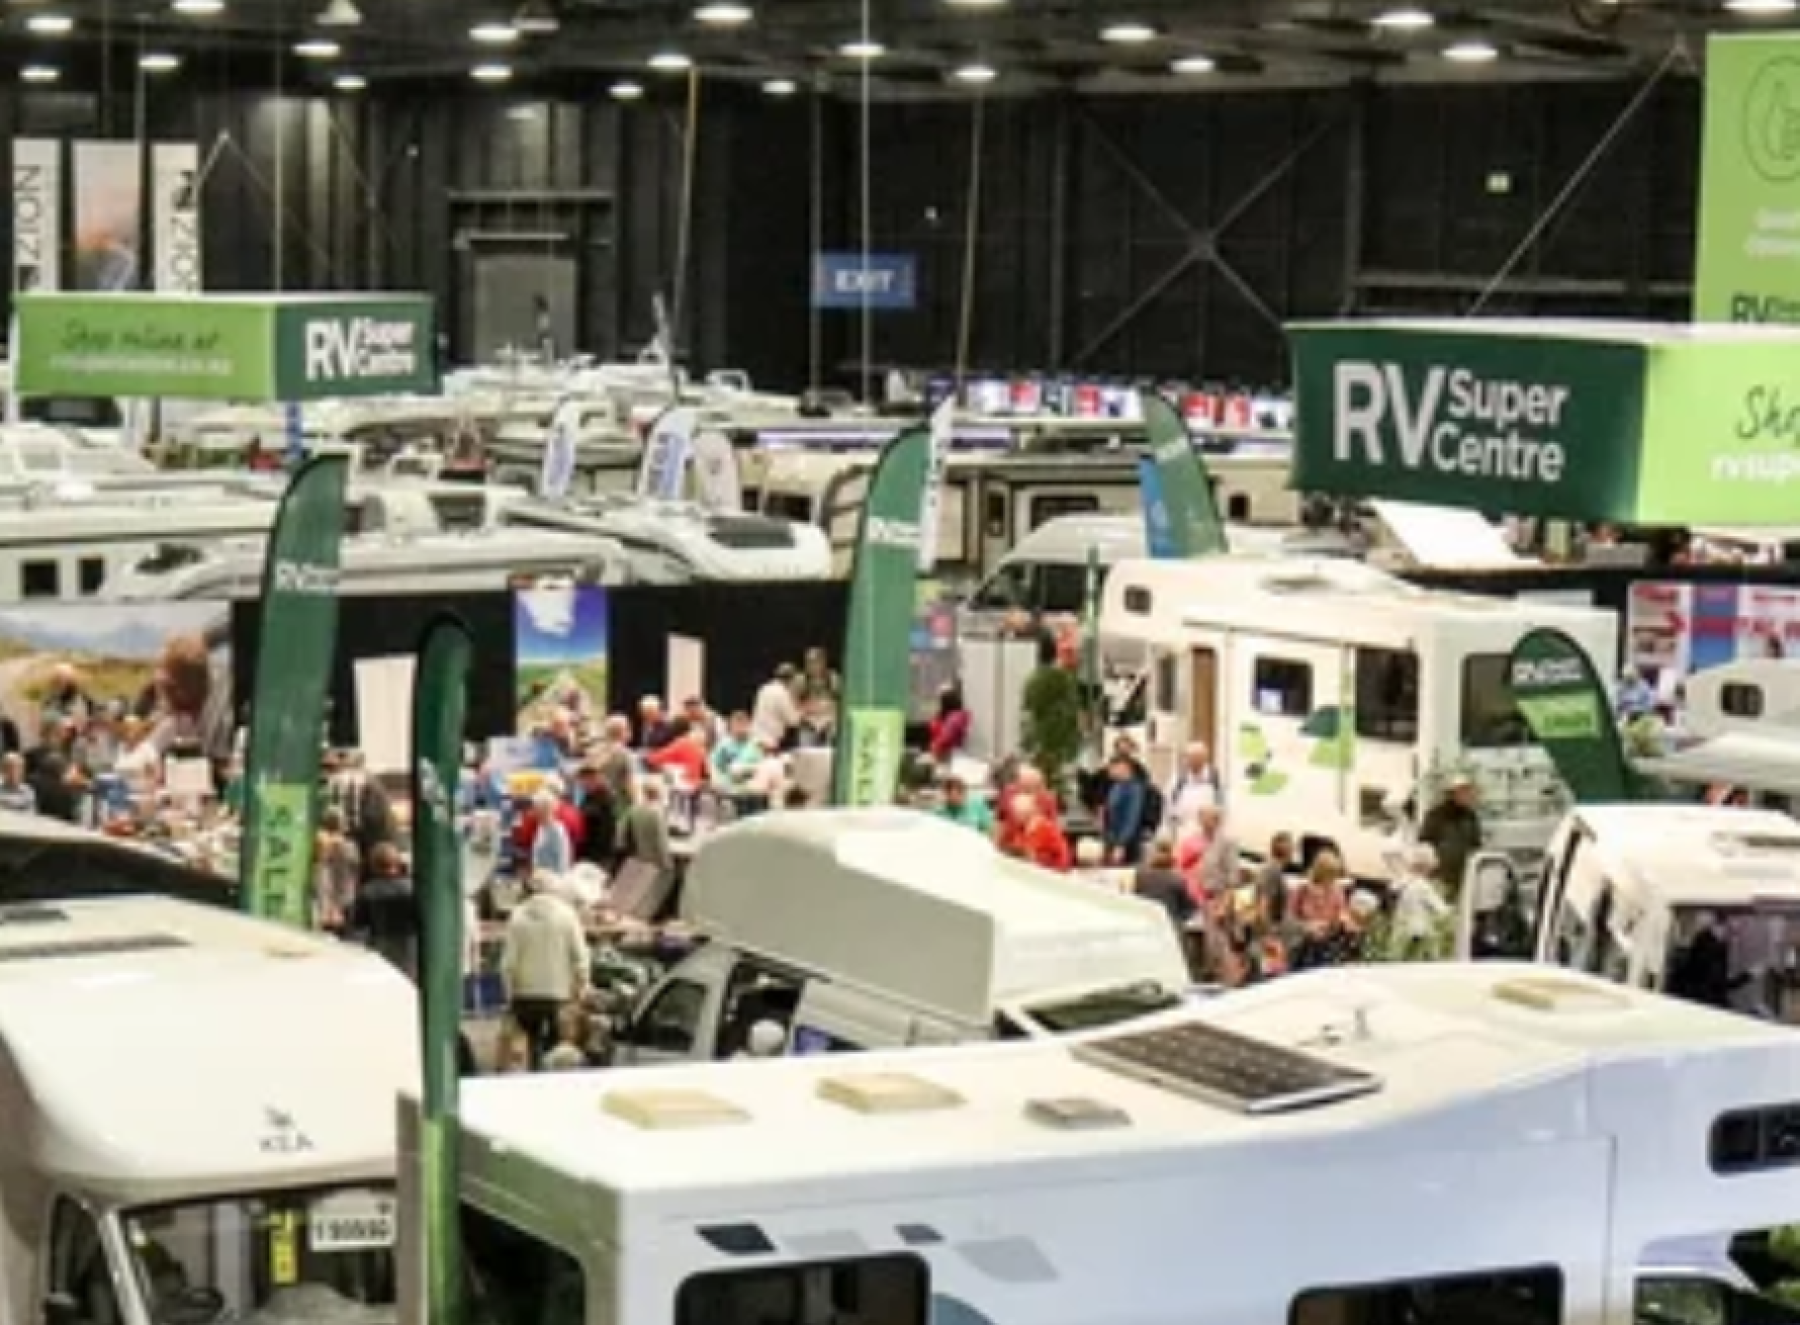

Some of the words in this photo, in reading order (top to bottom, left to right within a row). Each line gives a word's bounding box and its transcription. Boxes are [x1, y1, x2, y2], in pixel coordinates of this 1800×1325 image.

[306, 318, 360, 380] RV
[1333, 360, 1447, 469] RV
[1447, 367, 1570, 431] Super
[1432, 421, 1567, 482] Centre
